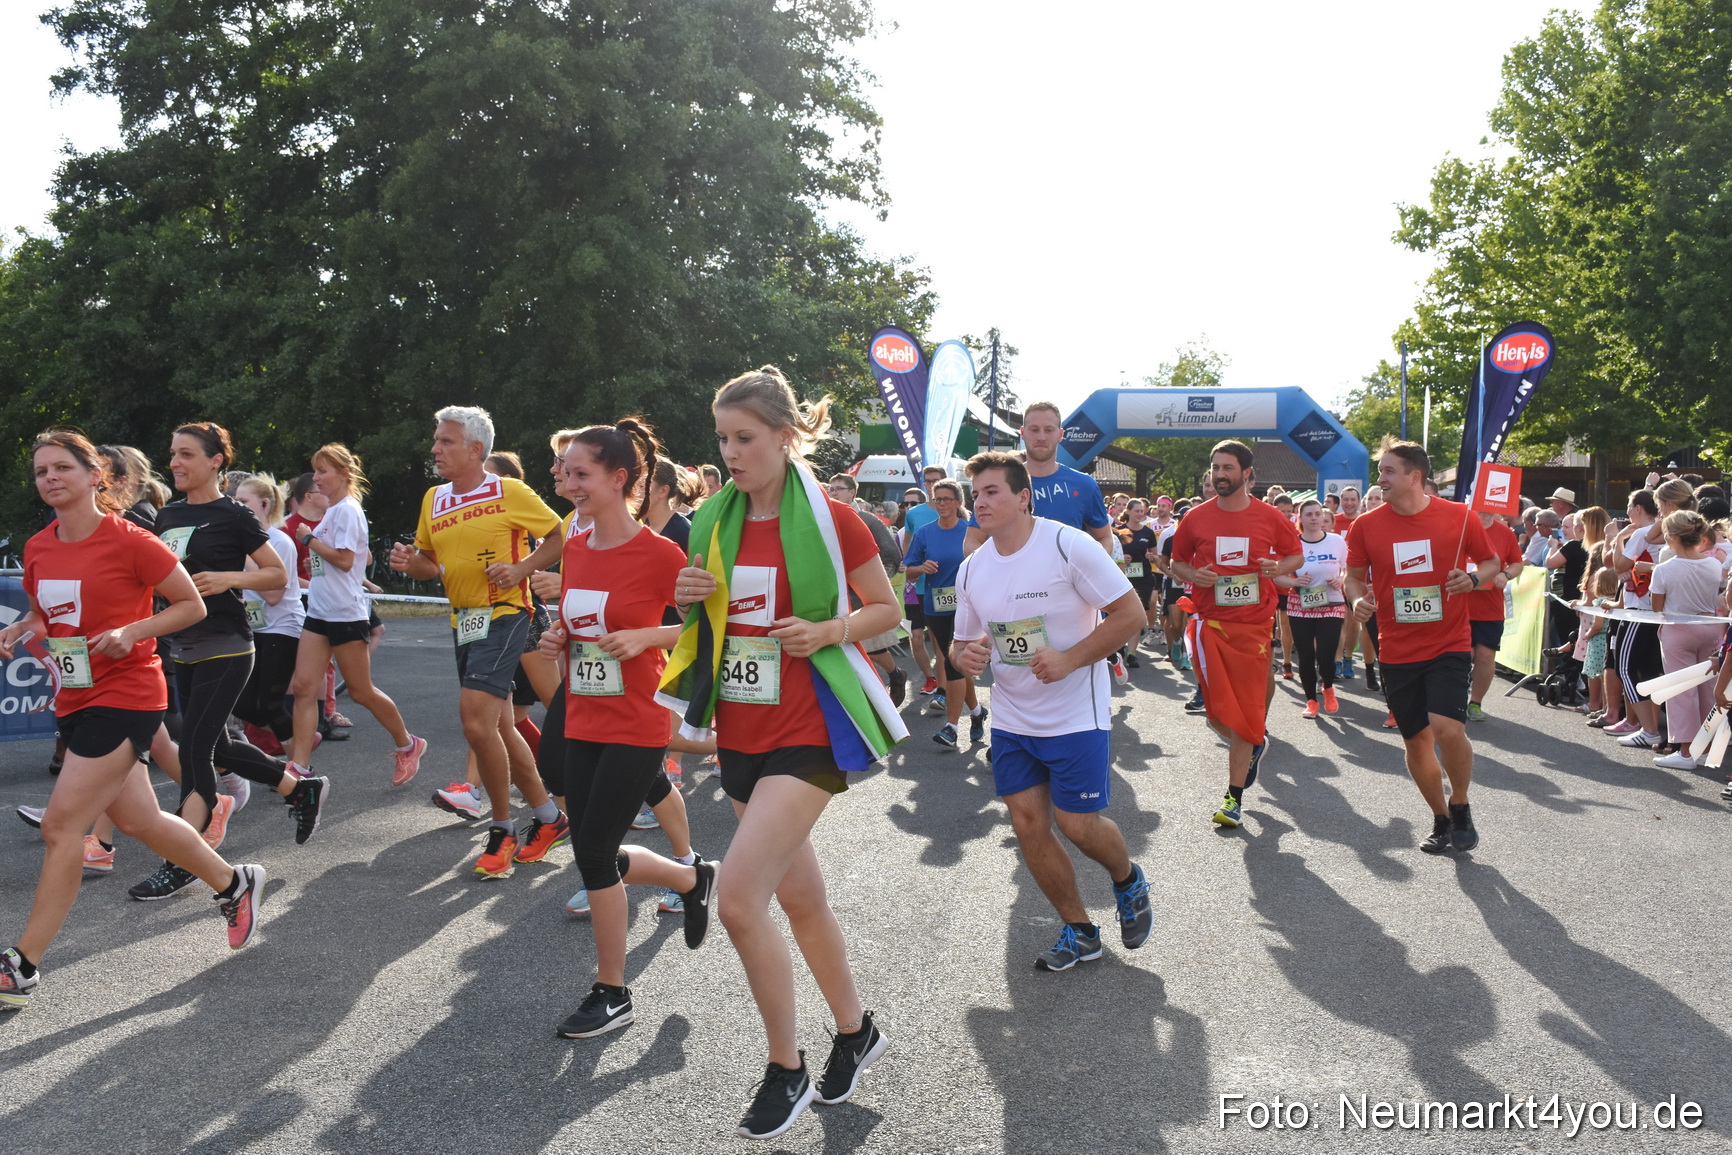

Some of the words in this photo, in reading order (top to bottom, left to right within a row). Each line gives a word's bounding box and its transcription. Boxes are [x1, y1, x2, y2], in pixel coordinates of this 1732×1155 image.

[1497, 342, 1545, 364] Hervis
[1178, 412, 1237, 423] firmenlauf
[1066, 431, 1098, 439] Fischer
[431, 515, 459, 535] MAX
[462, 504, 506, 521] BÖGL
[1015, 591, 1048, 600] auctores
[1224, 585, 1250, 598] 496
[1303, 593, 1325, 603] 2061
[738, 600, 756, 610] DEHN
[1404, 599, 1432, 613] 506
[460, 616, 485, 634] 1668
[1006, 637, 1028, 653] 29
[576, 661, 606, 681] 473
[722, 659, 759, 685] 548
